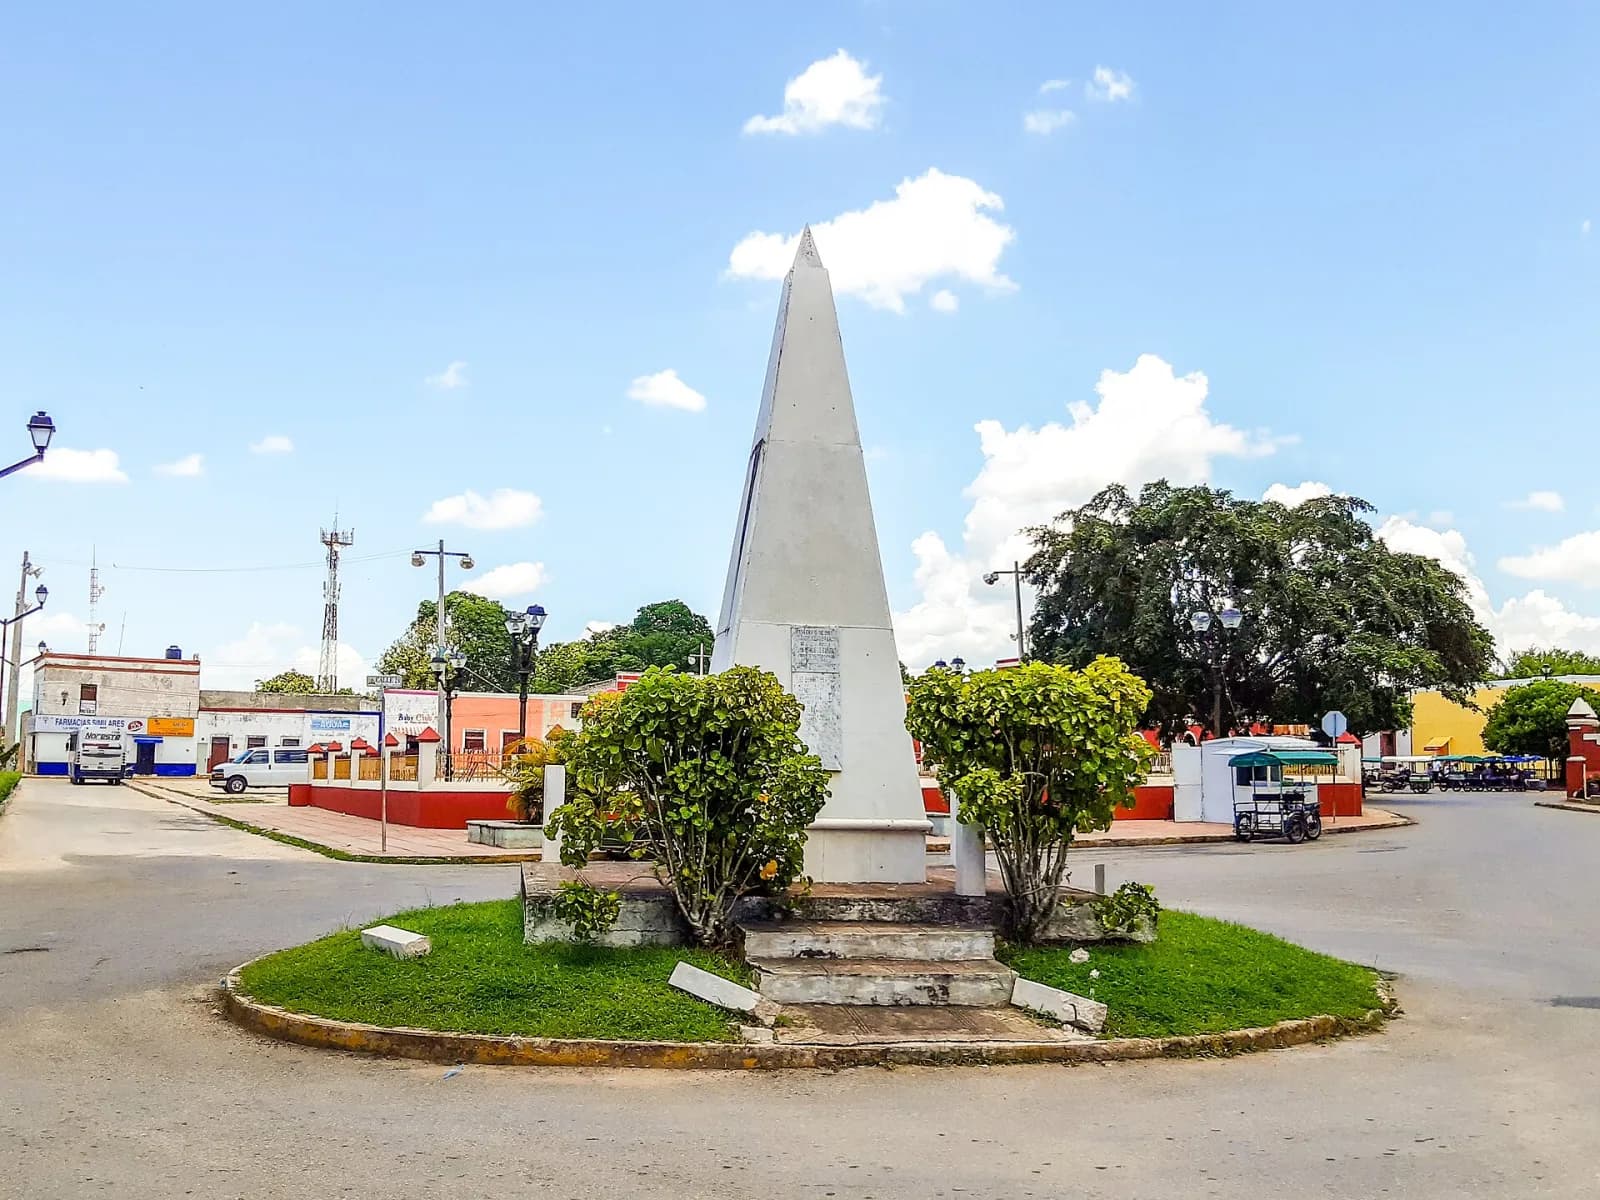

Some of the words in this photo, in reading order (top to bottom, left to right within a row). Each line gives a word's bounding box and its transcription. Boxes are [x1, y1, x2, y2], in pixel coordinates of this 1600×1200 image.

[376, 676, 393, 684] CALLE
[398, 713, 413, 721] Baby
[55, 718, 91, 727] FARMACIAS
[92, 719, 124, 727] SIMILARES
[85, 732, 121, 740] Noreste
